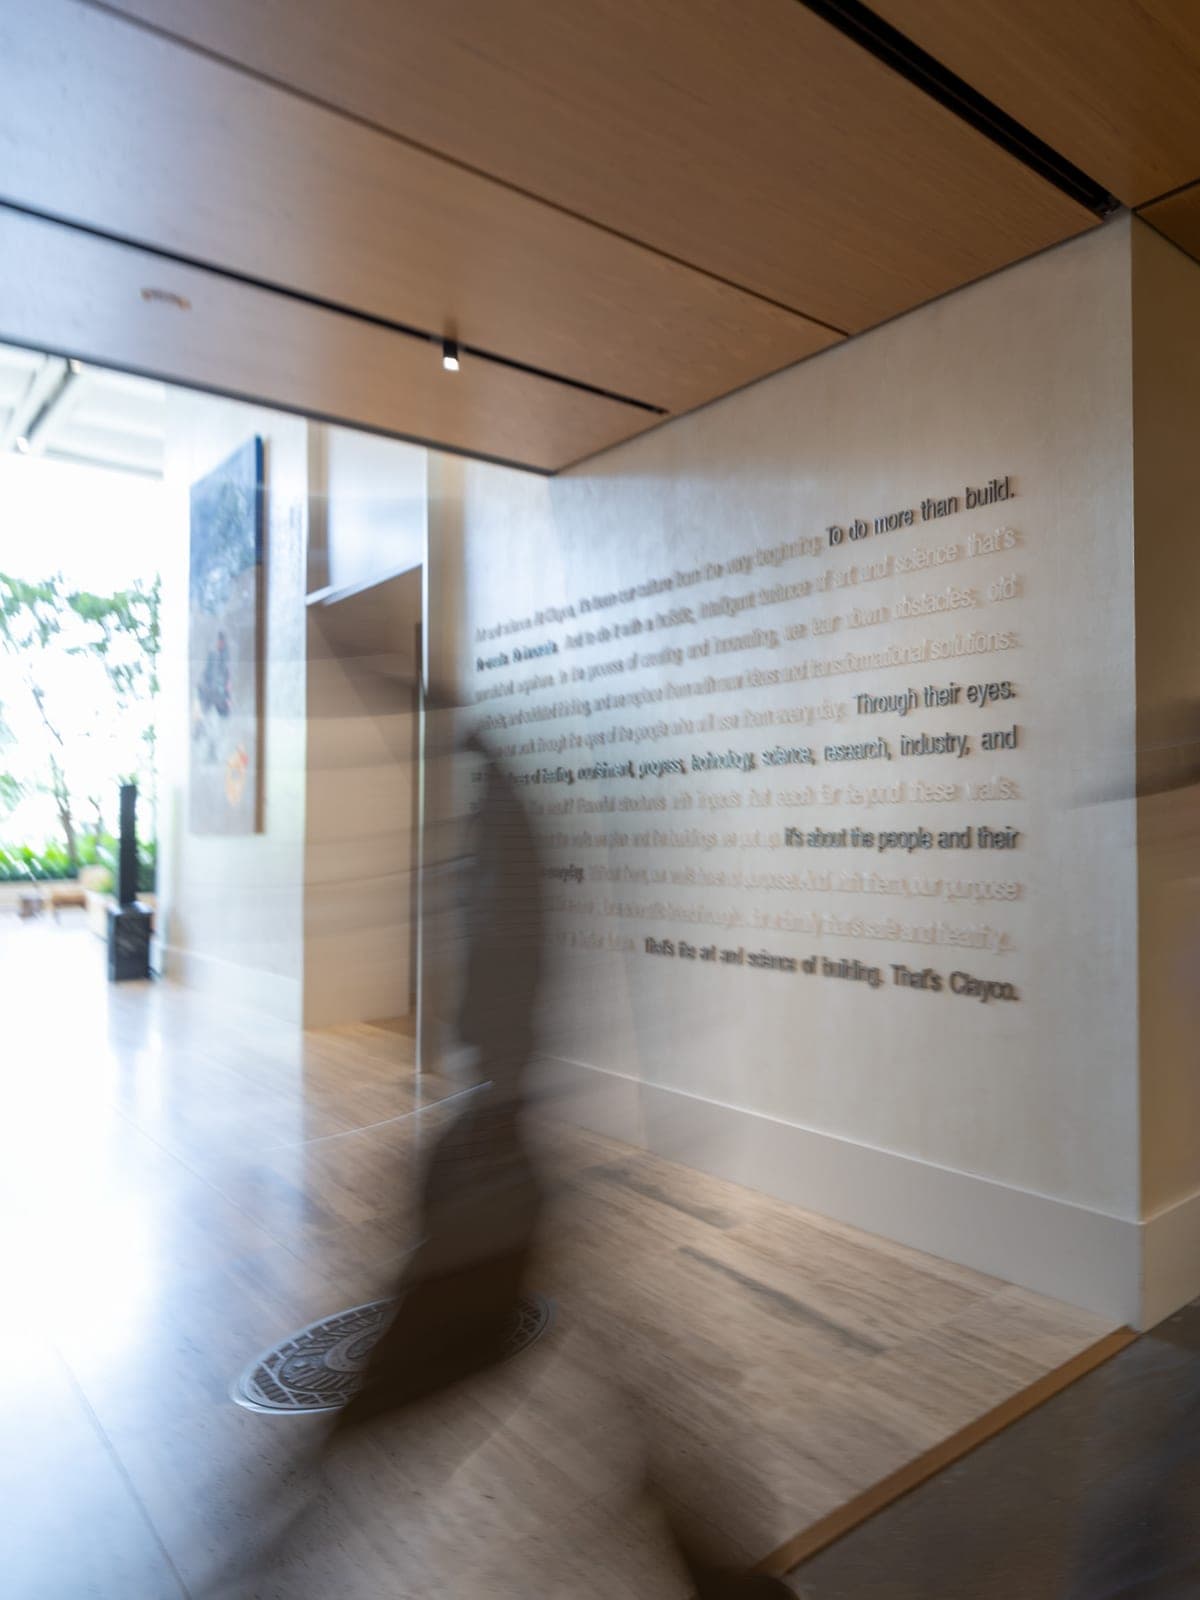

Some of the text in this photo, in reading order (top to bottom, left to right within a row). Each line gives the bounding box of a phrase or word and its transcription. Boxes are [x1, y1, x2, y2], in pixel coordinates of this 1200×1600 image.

[826, 525, 843, 547] To
[849, 520, 868, 541] do
[874, 509, 914, 534] more
[921, 495, 958, 521] than
[965, 476, 1015, 509] build.
[895, 540, 958, 573] science
[967, 525, 1017, 558] that's
[854, 688, 917, 716] Through
[924, 682, 961, 708] their
[967, 680, 1017, 708] eyes.
[761, 744, 816, 766] science,
[824, 736, 892, 763] research,
[900, 731, 970, 758] industry,
[982, 725, 1017, 750] and
[807, 827, 847, 847] about
[851, 827, 874, 848] the
[878, 827, 933, 852] people
[938, 826, 971, 849] and
[977, 826, 1019, 849] their
[720, 946, 743, 965] and
[747, 949, 797, 972] science
[802, 955, 817, 974] of
[823, 957, 884, 988] building.
[890, 963, 942, 991] That's
[949, 970, 1019, 1003] Clayco.
